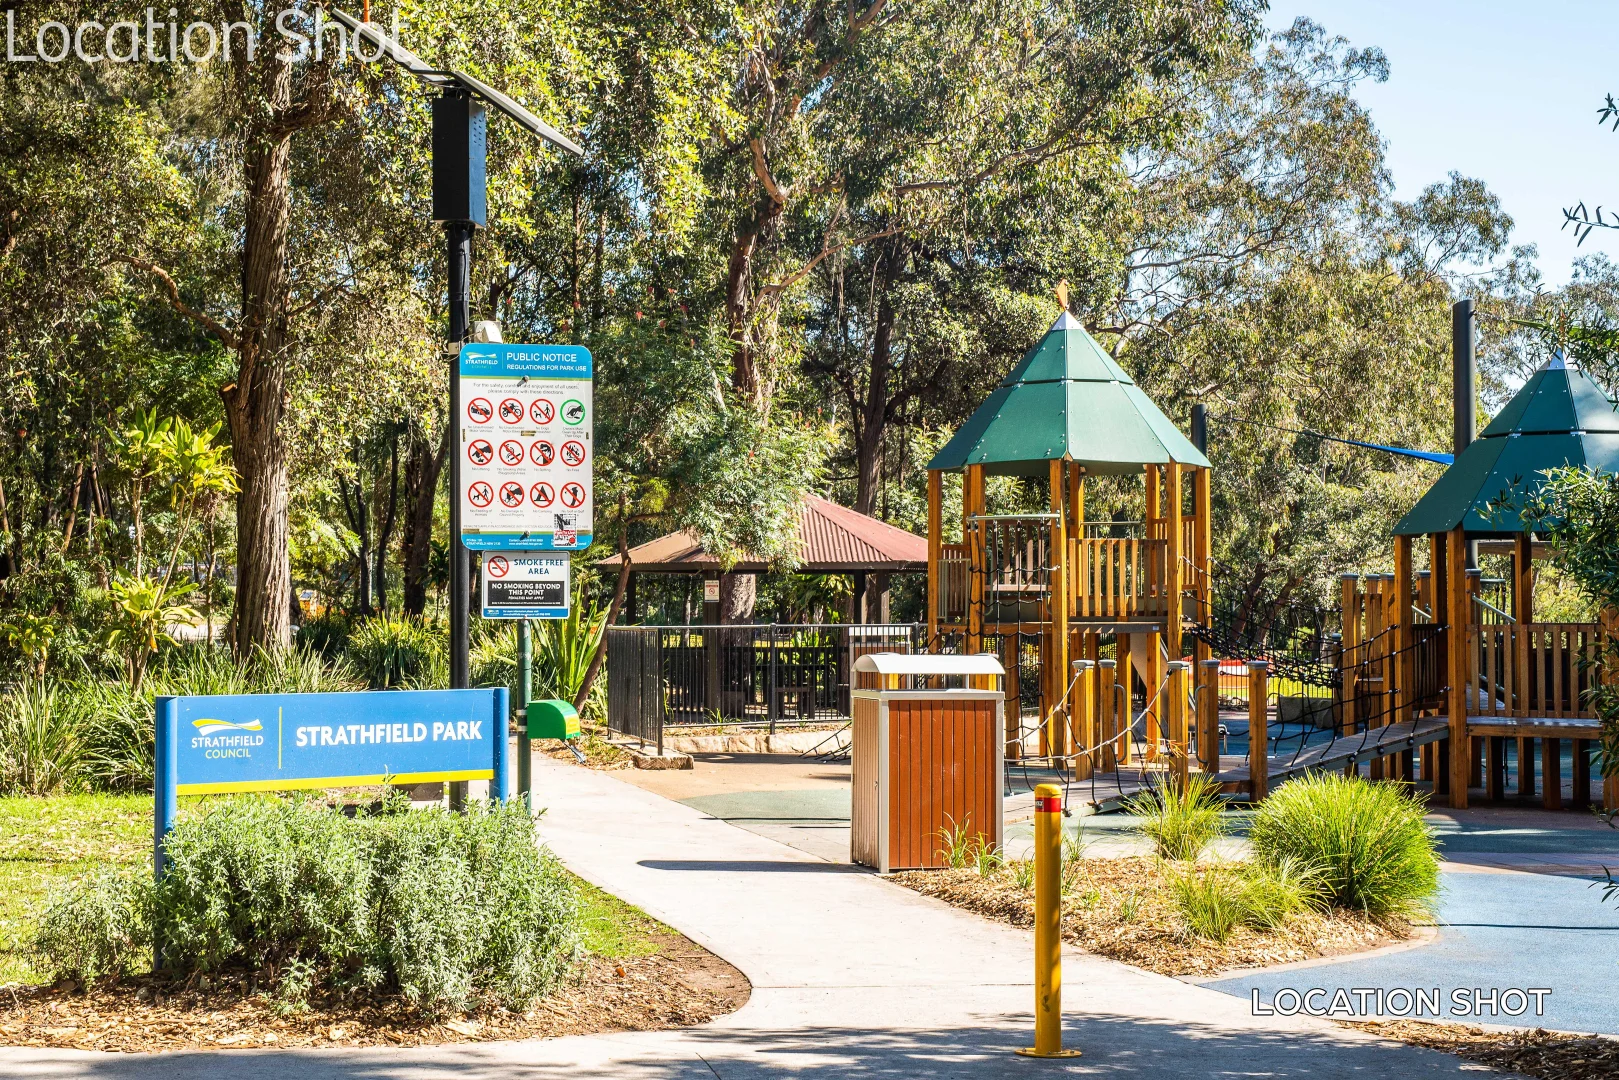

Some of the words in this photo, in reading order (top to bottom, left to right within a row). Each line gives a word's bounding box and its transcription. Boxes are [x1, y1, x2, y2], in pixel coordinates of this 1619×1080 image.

[506, 353, 540, 362] PUBLIC
[542, 353, 577, 362] NOTICE
[296, 722, 427, 747] STRATHFIELD
[432, 720, 483, 741] PARK
[191, 734, 264, 748] STRATHFIELD
[205, 748, 252, 759] COUNCIL
